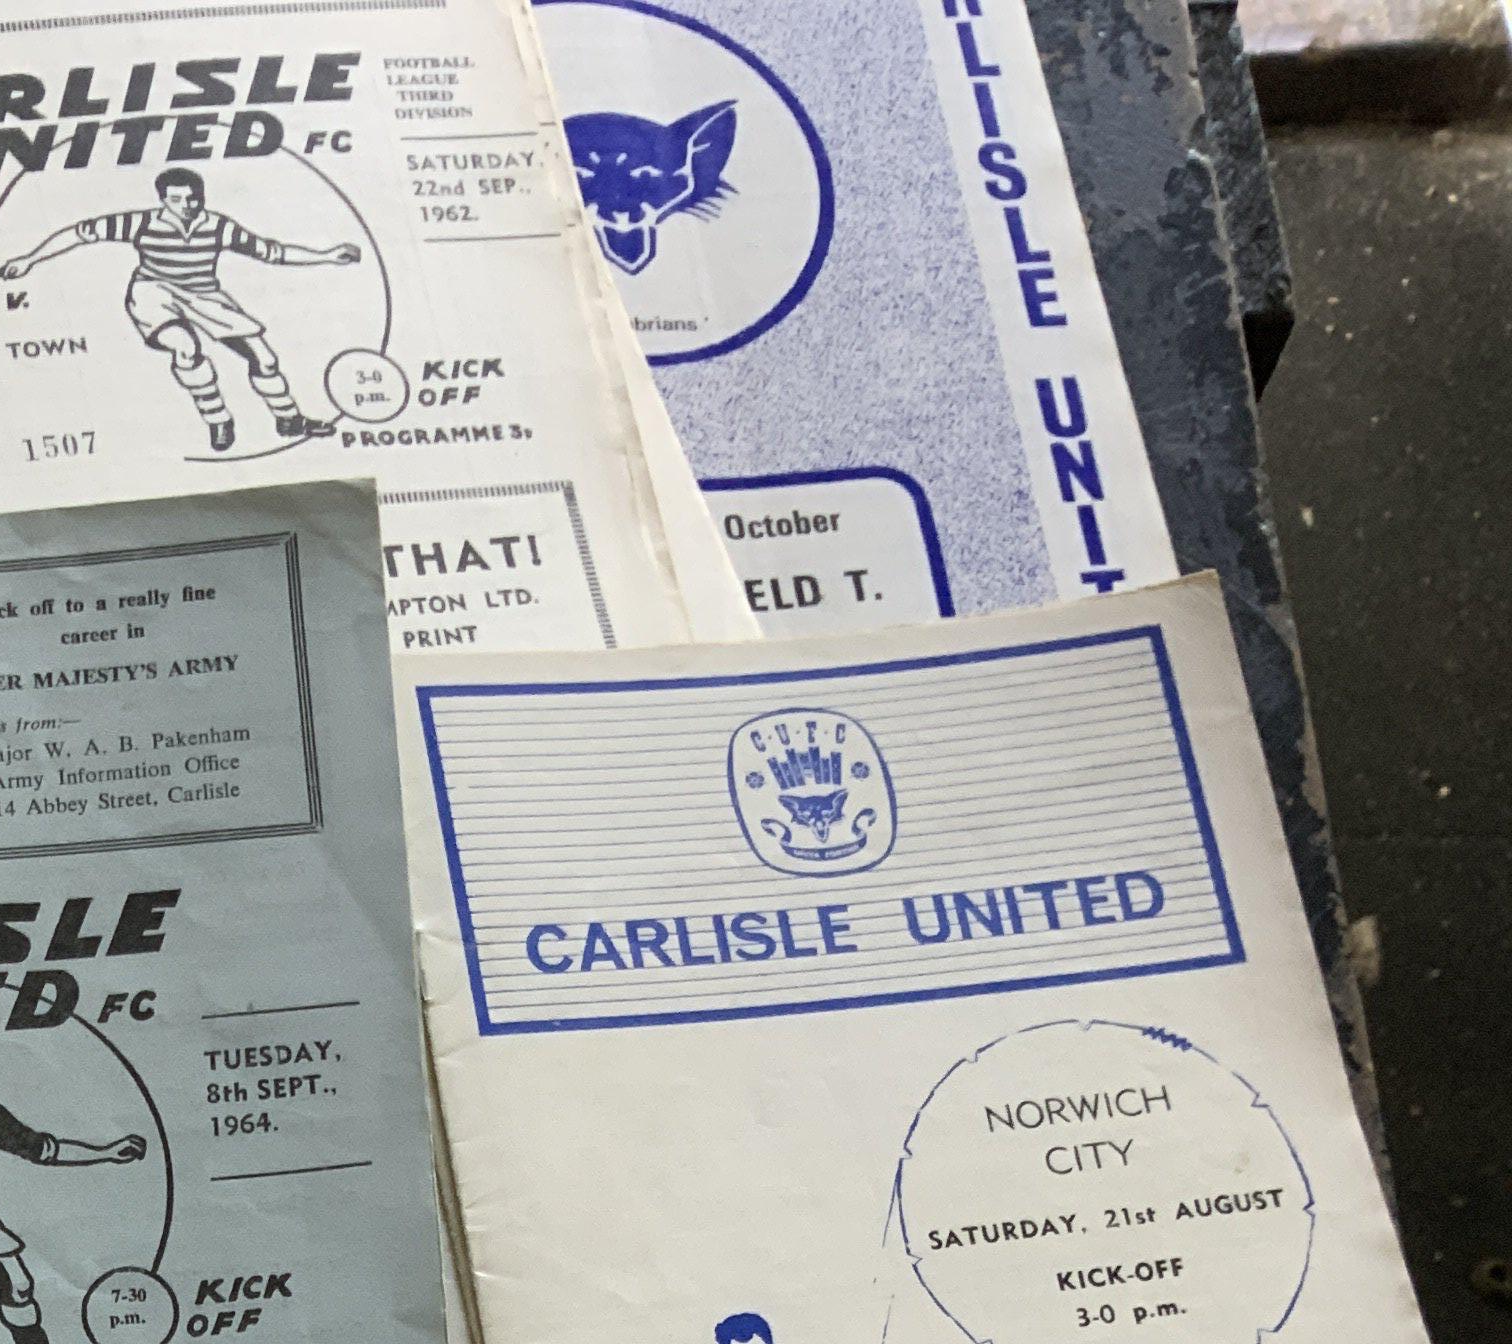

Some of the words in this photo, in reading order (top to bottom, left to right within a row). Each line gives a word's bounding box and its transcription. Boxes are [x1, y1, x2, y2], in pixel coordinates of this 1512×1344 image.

[384, 57, 474, 69] FOOTBALL
[387, 74, 458, 85] LEAGUE
[400, 90, 453, 101] THIRD
[395, 107, 472, 119] DIVISION
[413, 180, 464, 196] 22nd
[6, 338, 87, 358] TOWN
[423, 358, 504, 381] KICK
[418, 386, 480, 407] OFF
[23, 431, 95, 461] 1507
[342, 425, 502, 447] PROGRAMME
[725, 510, 839, 540] October
[383, 535, 541, 577] THAT!
[30, 599, 54, 615] off
[66, 599, 84, 613] to
[96, 599, 106, 610] a
[119, 589, 169, 608] really
[183, 586, 215, 601] fine
[61, 629, 117, 644] career
[127, 623, 144, 639] in
[403, 625, 477, 648] PRINT
[34, 663, 157, 689] MAJESTY'S
[169, 655, 238, 677] ARMY
[152, 727, 250, 749] Pakenham
[59, 762, 171, 785] Information
[185, 755, 239, 773] Office
[27, 797, 87, 815] Abbey
[168, 782, 239, 803] Carlisle
[525, 905, 859, 973] CARLISLE
[904, 872, 1165, 946] UNITED
[204, 1040, 340, 1070] TUESDAY,
[985, 1086, 1171, 1132] NORWICH
[211, 1113, 278, 1136] 1964.
[1046, 1139, 1133, 1174] CITY
[1105, 1208, 1155, 1228] 21st
[1176, 1189, 1283, 1219] AUGUST
[1057, 1258, 1183, 1291] KICK-OFF
[1133, 1303, 1186, 1324] p.m.
